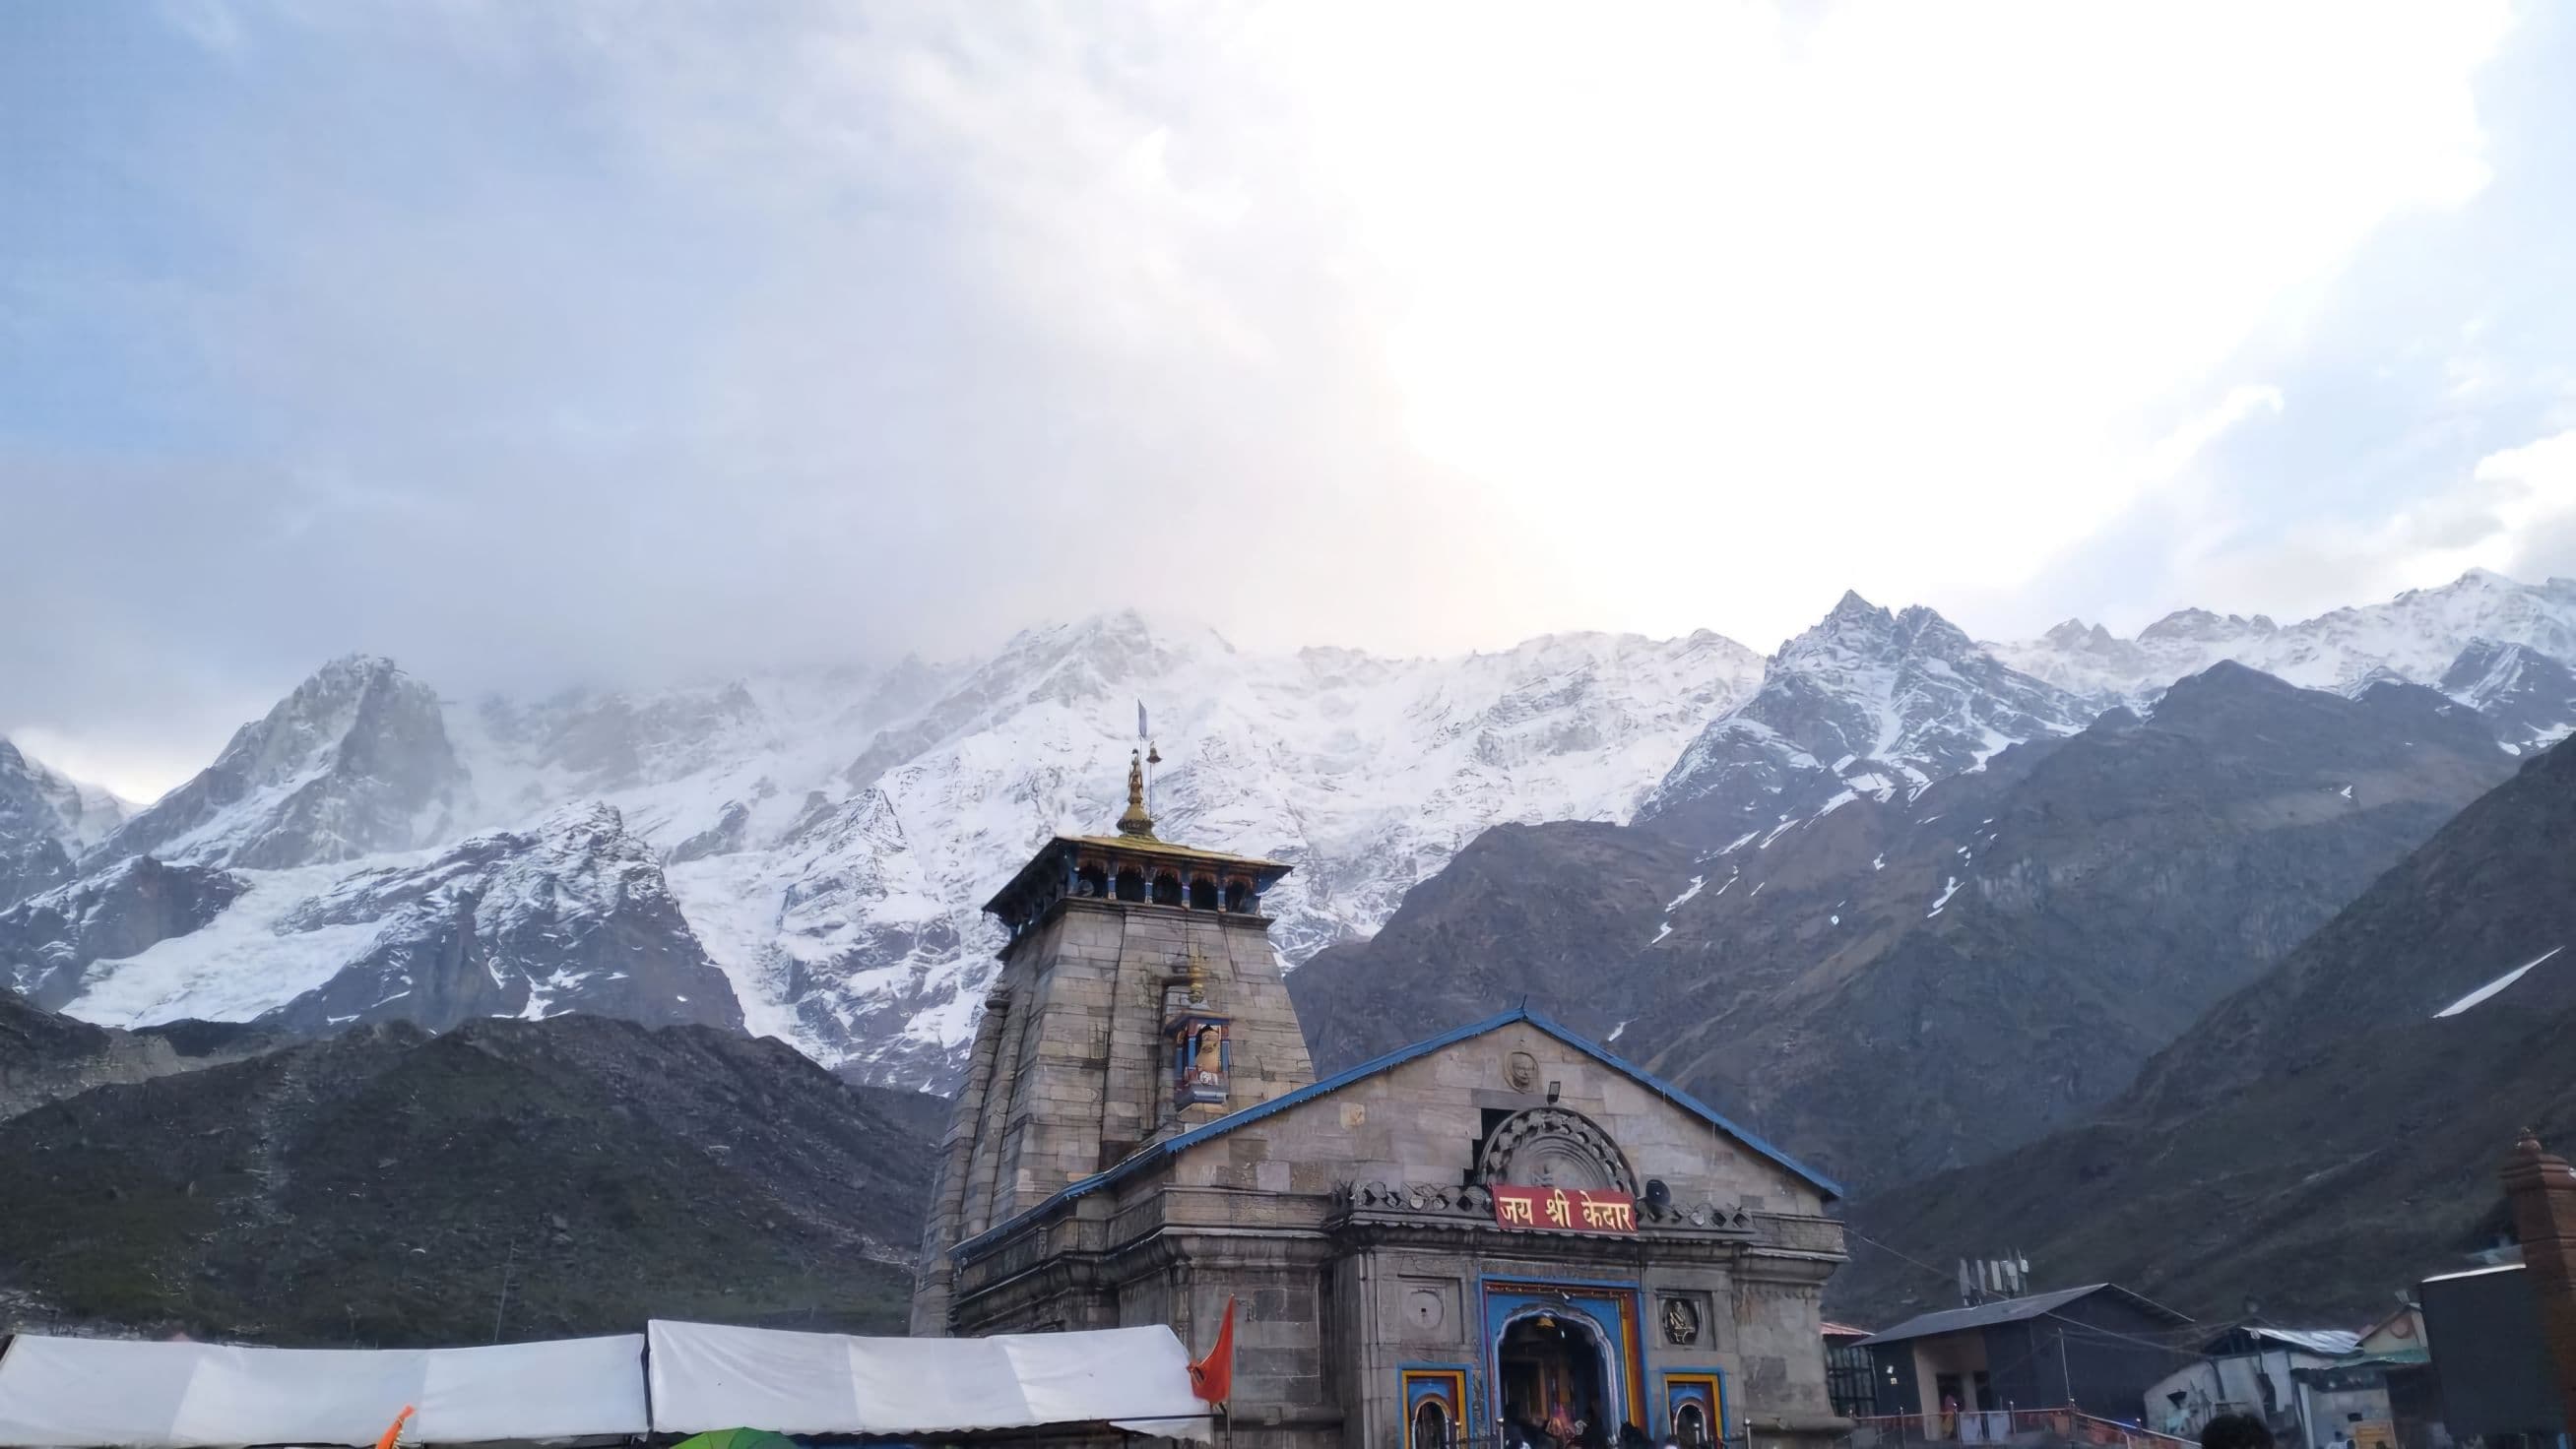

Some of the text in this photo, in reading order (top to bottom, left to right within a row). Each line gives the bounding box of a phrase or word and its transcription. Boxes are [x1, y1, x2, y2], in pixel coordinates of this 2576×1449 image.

[1499, 1188, 1635, 1230] जय श्री केदार
